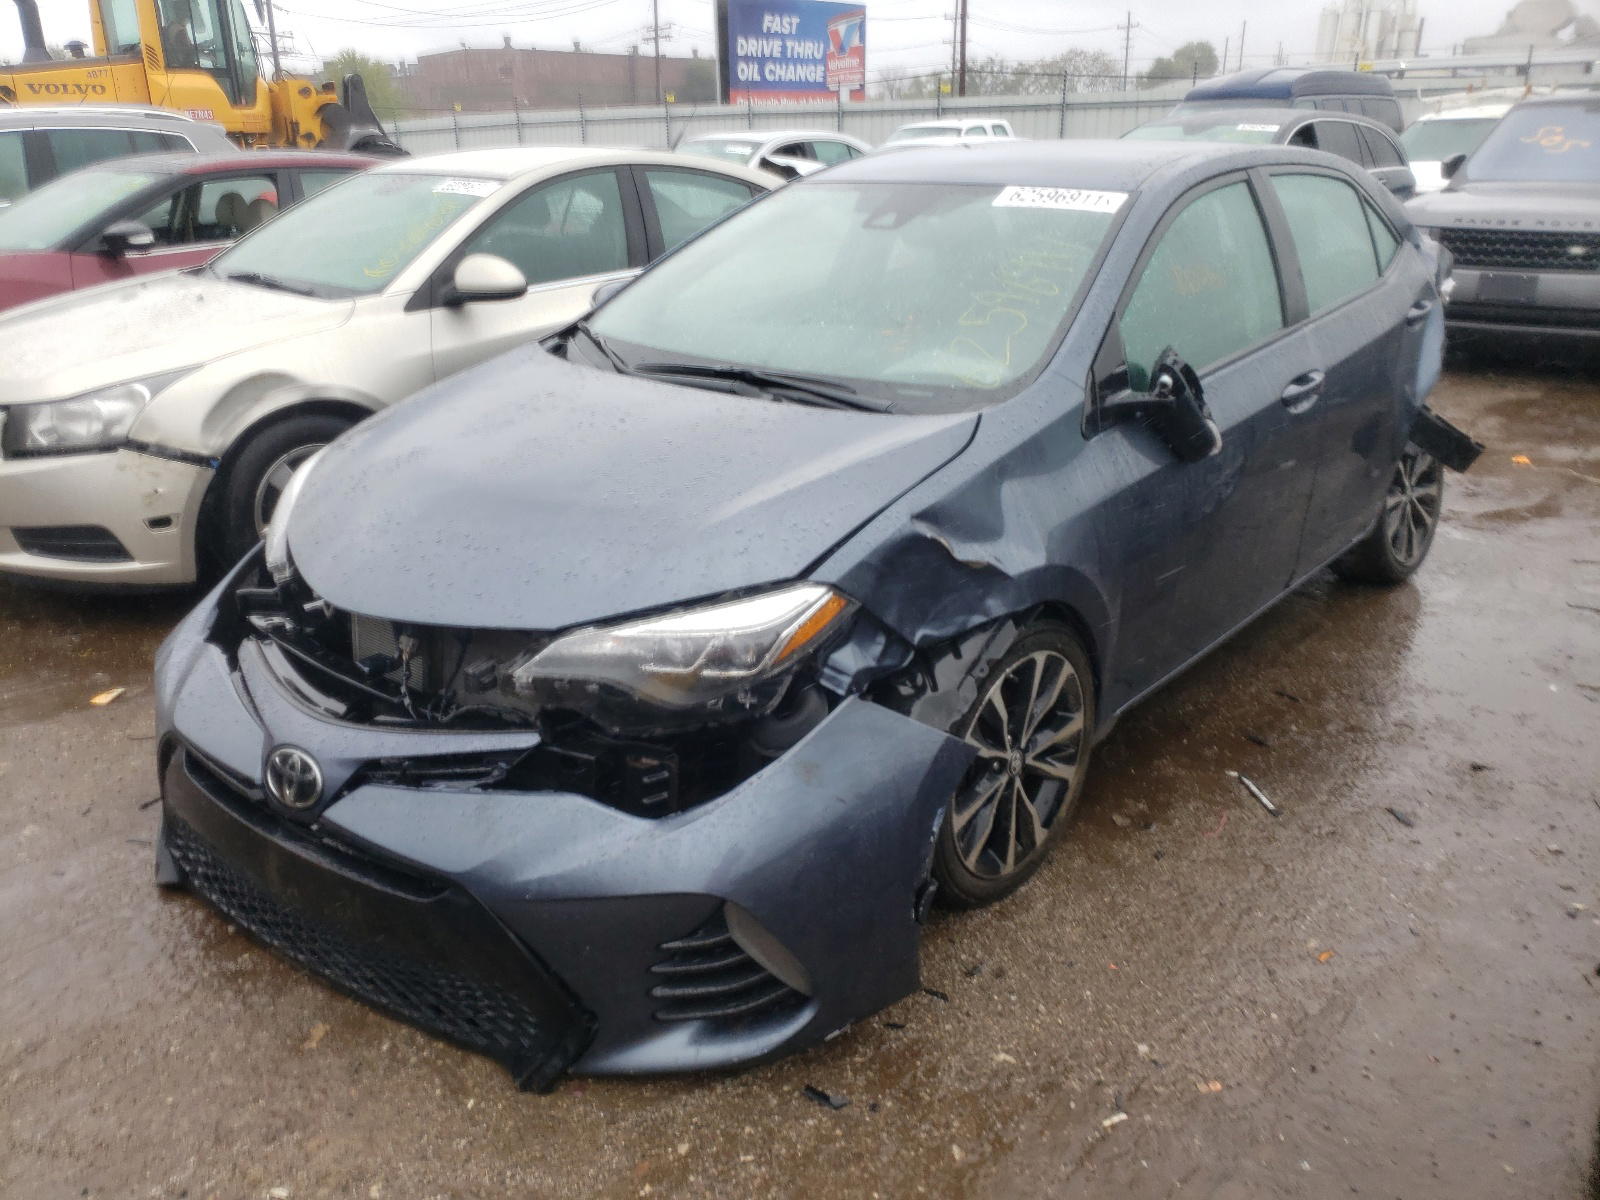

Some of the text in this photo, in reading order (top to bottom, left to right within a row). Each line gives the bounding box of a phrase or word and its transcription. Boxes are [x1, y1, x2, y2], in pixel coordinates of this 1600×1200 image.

[763, 14, 800, 34] FAST
[737, 38, 824, 59] DRIVE THRU
[737, 62, 760, 81] OIL
[764, 62, 825, 82] CHANGE
[24, 83, 106, 95] VOLVO
